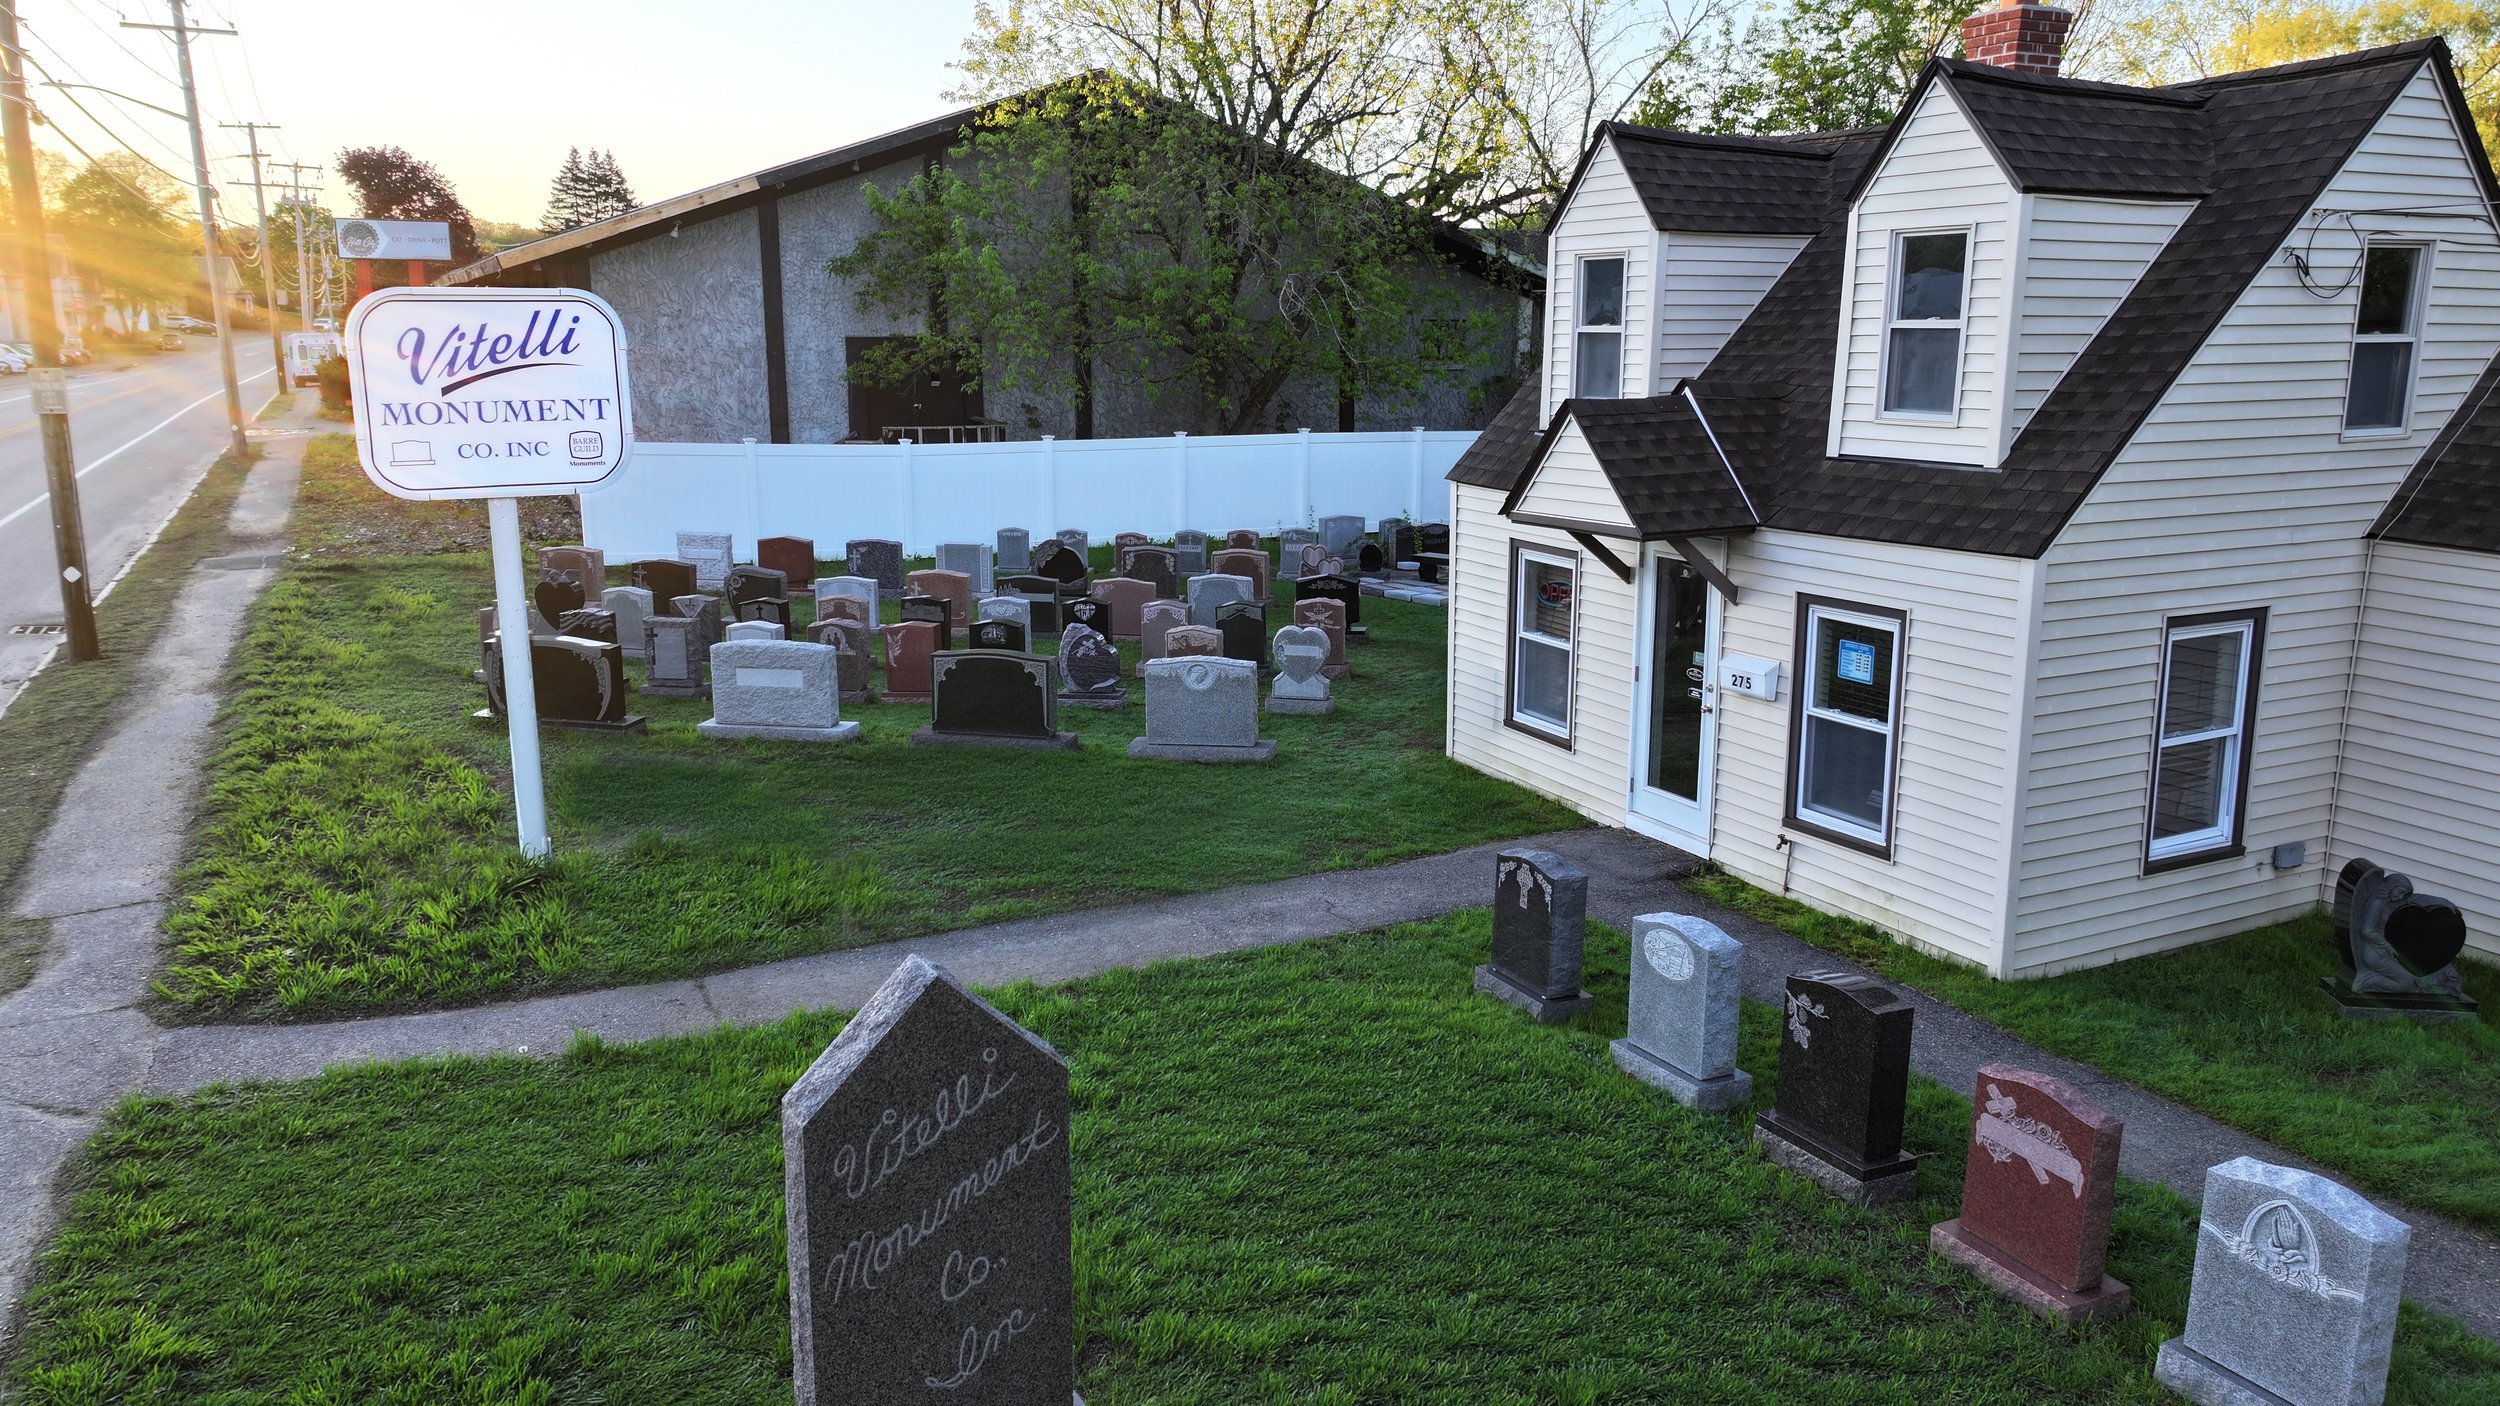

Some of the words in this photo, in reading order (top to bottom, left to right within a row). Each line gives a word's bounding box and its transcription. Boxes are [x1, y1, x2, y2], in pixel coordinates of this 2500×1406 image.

[397, 309, 580, 386] Vitelli
[380, 398, 610, 426] MONUMENT
[457, 443, 499, 459] CO.
[506, 441, 550, 458] INC
[573, 437, 599, 445] BARRE
[573, 445, 599, 453] GUILD
[1731, 674, 1752, 690] 275
[834, 1047, 1016, 1199] Vitelli
[825, 1110, 1059, 1304] Monument
